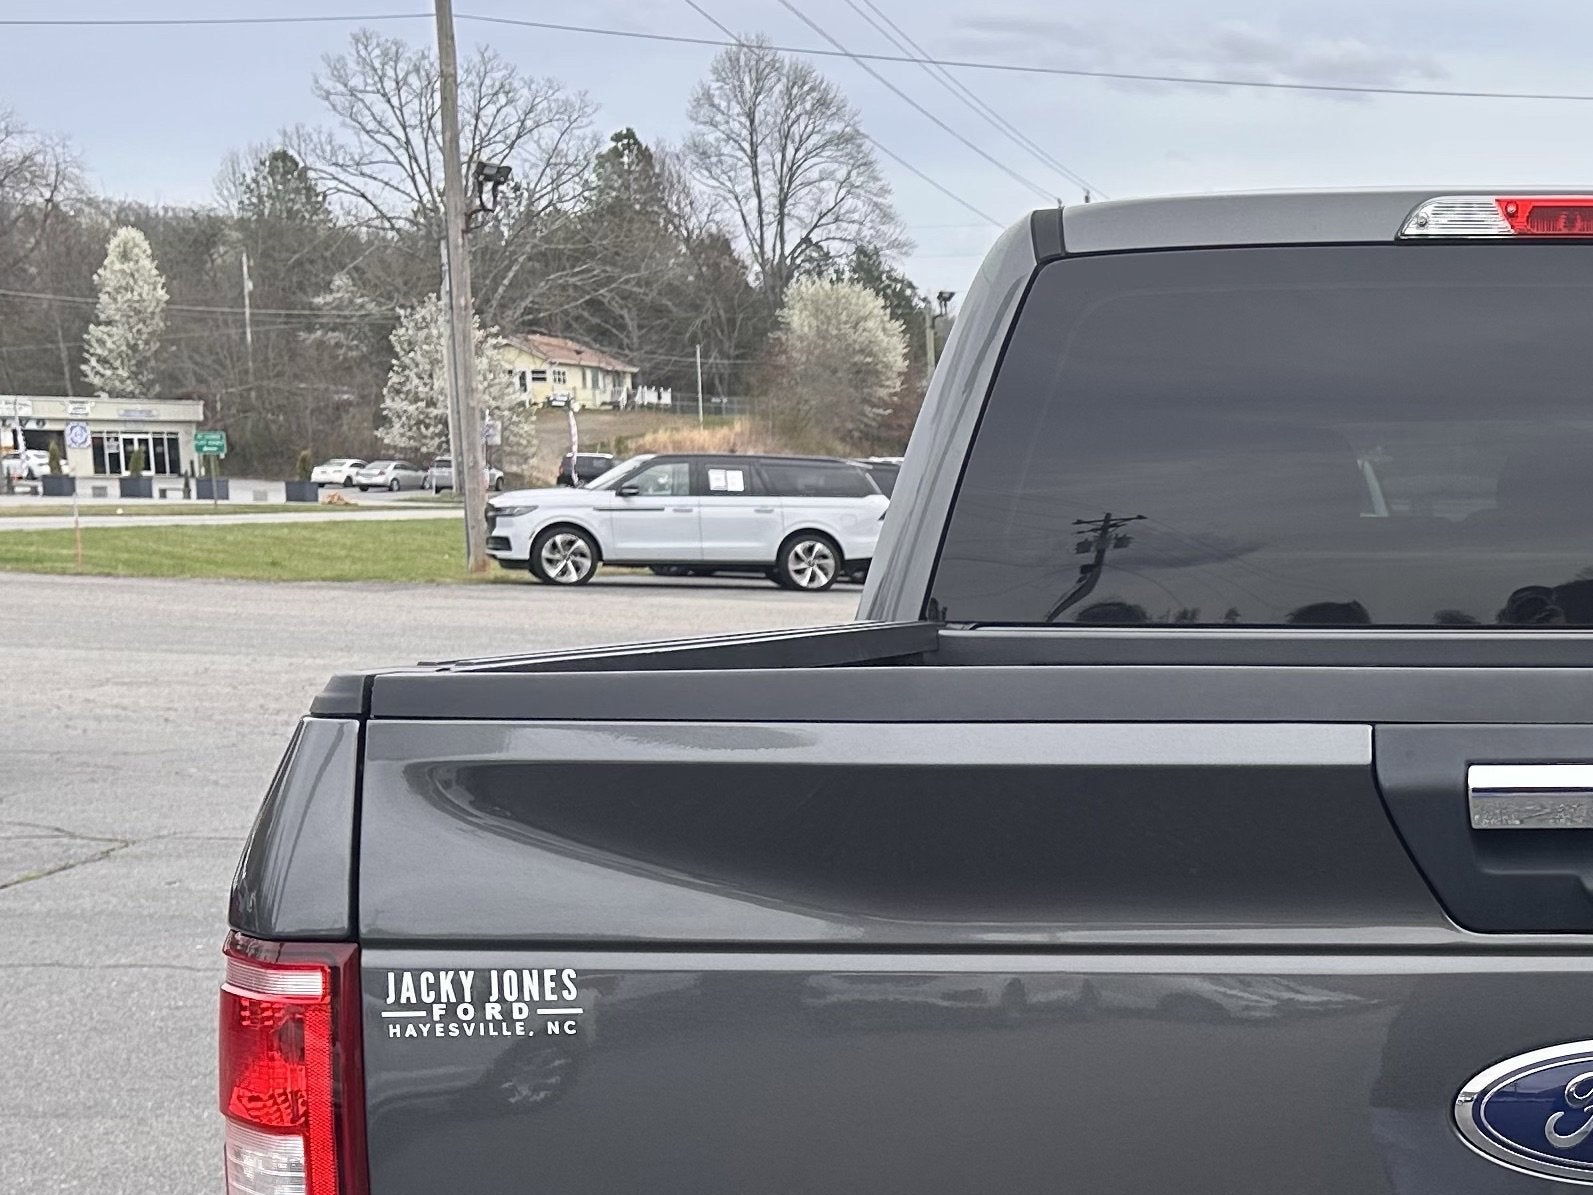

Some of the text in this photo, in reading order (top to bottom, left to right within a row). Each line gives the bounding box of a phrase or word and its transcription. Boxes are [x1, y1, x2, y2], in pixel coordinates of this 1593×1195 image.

[386, 968, 578, 1004] JACKY JONES
[432, 1002, 529, 1021] FORD
[388, 1020, 577, 1038] HAYESVILLE, NC
